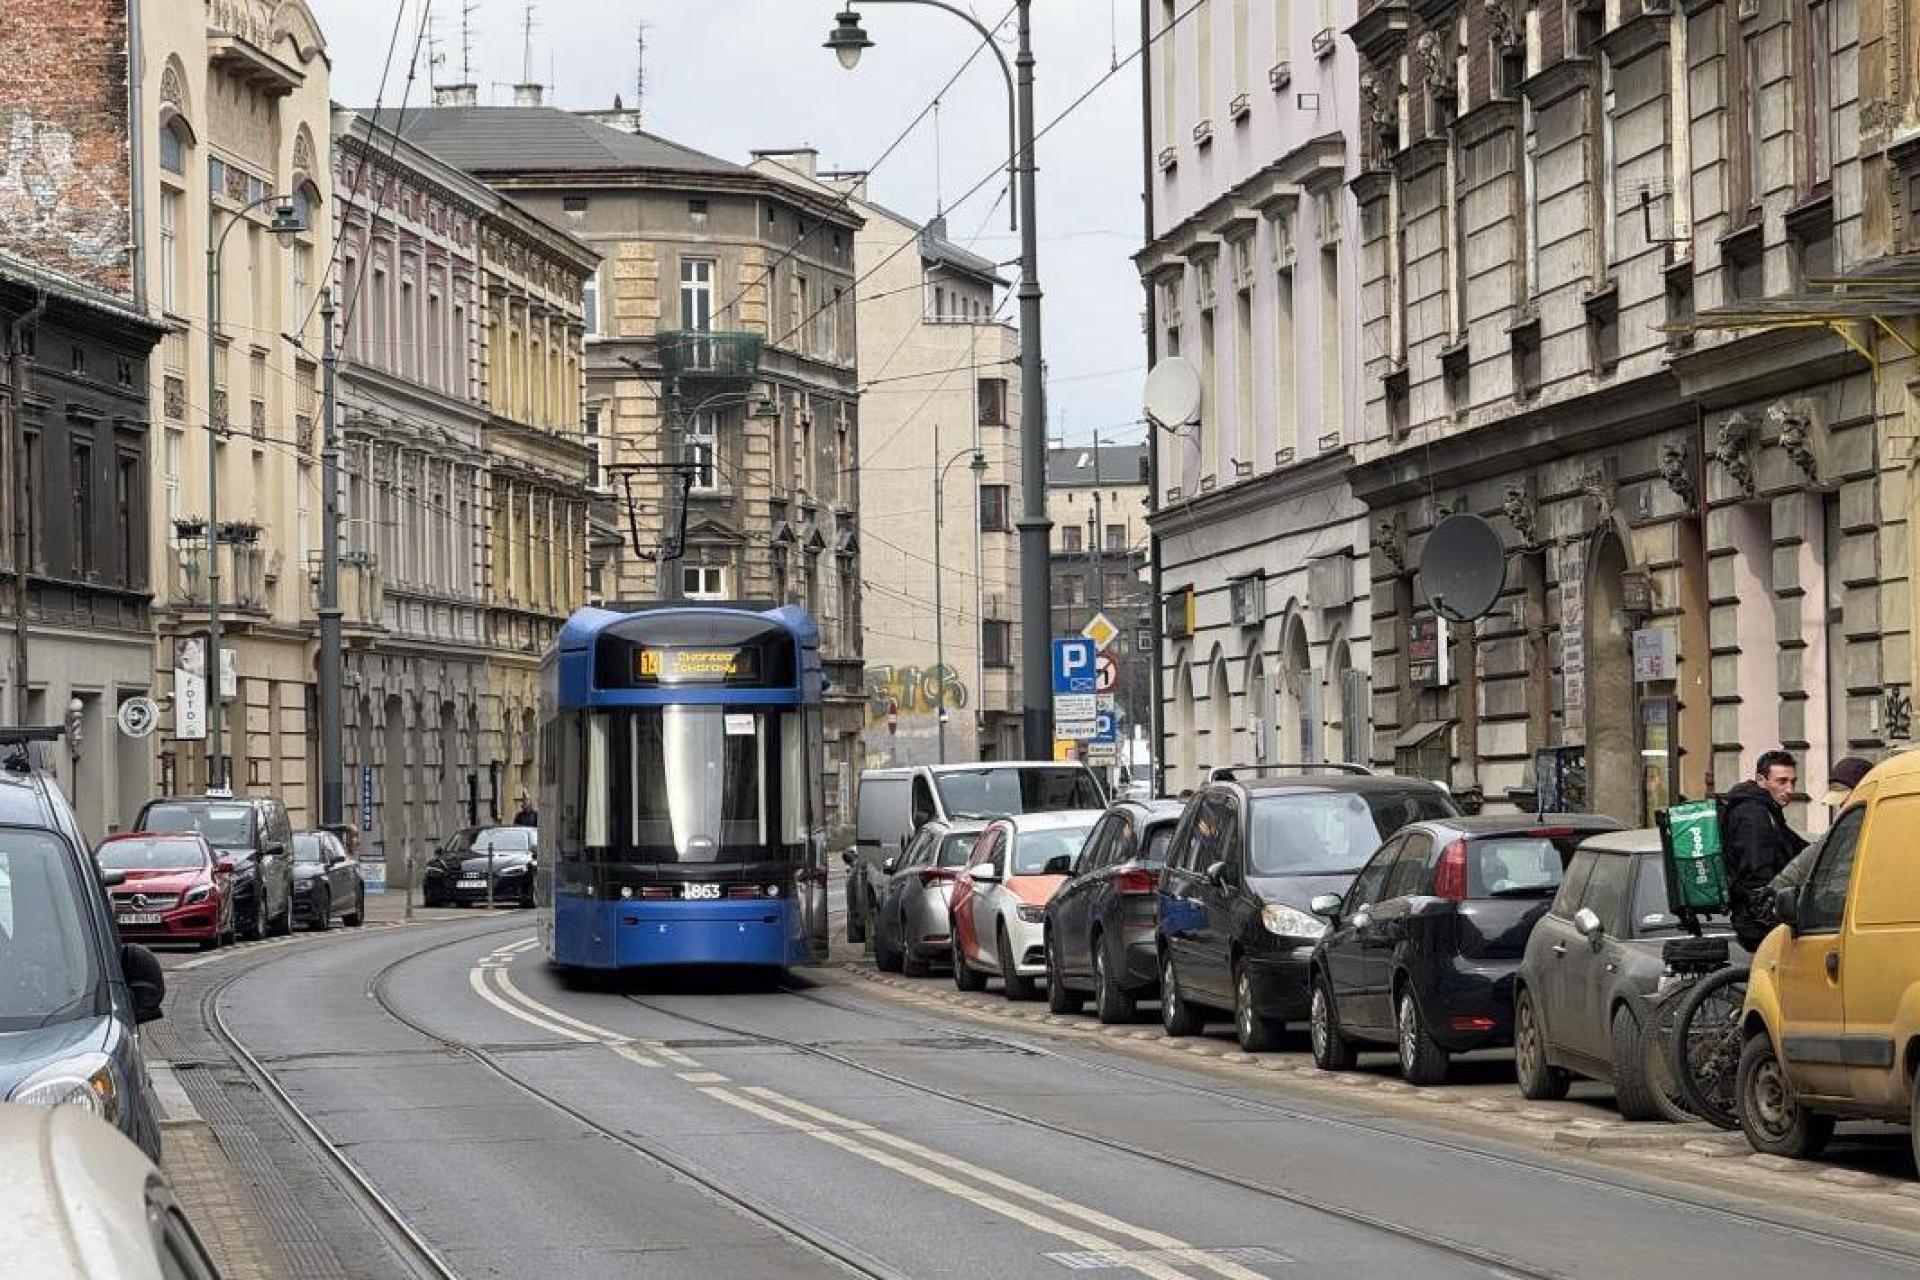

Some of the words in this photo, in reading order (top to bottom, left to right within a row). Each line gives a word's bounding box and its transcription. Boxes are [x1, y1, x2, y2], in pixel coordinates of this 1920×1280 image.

[1062, 643, 1087, 677] P
[186, 678, 196, 720] FOTO
[1688, 826, 1704, 858] Food
